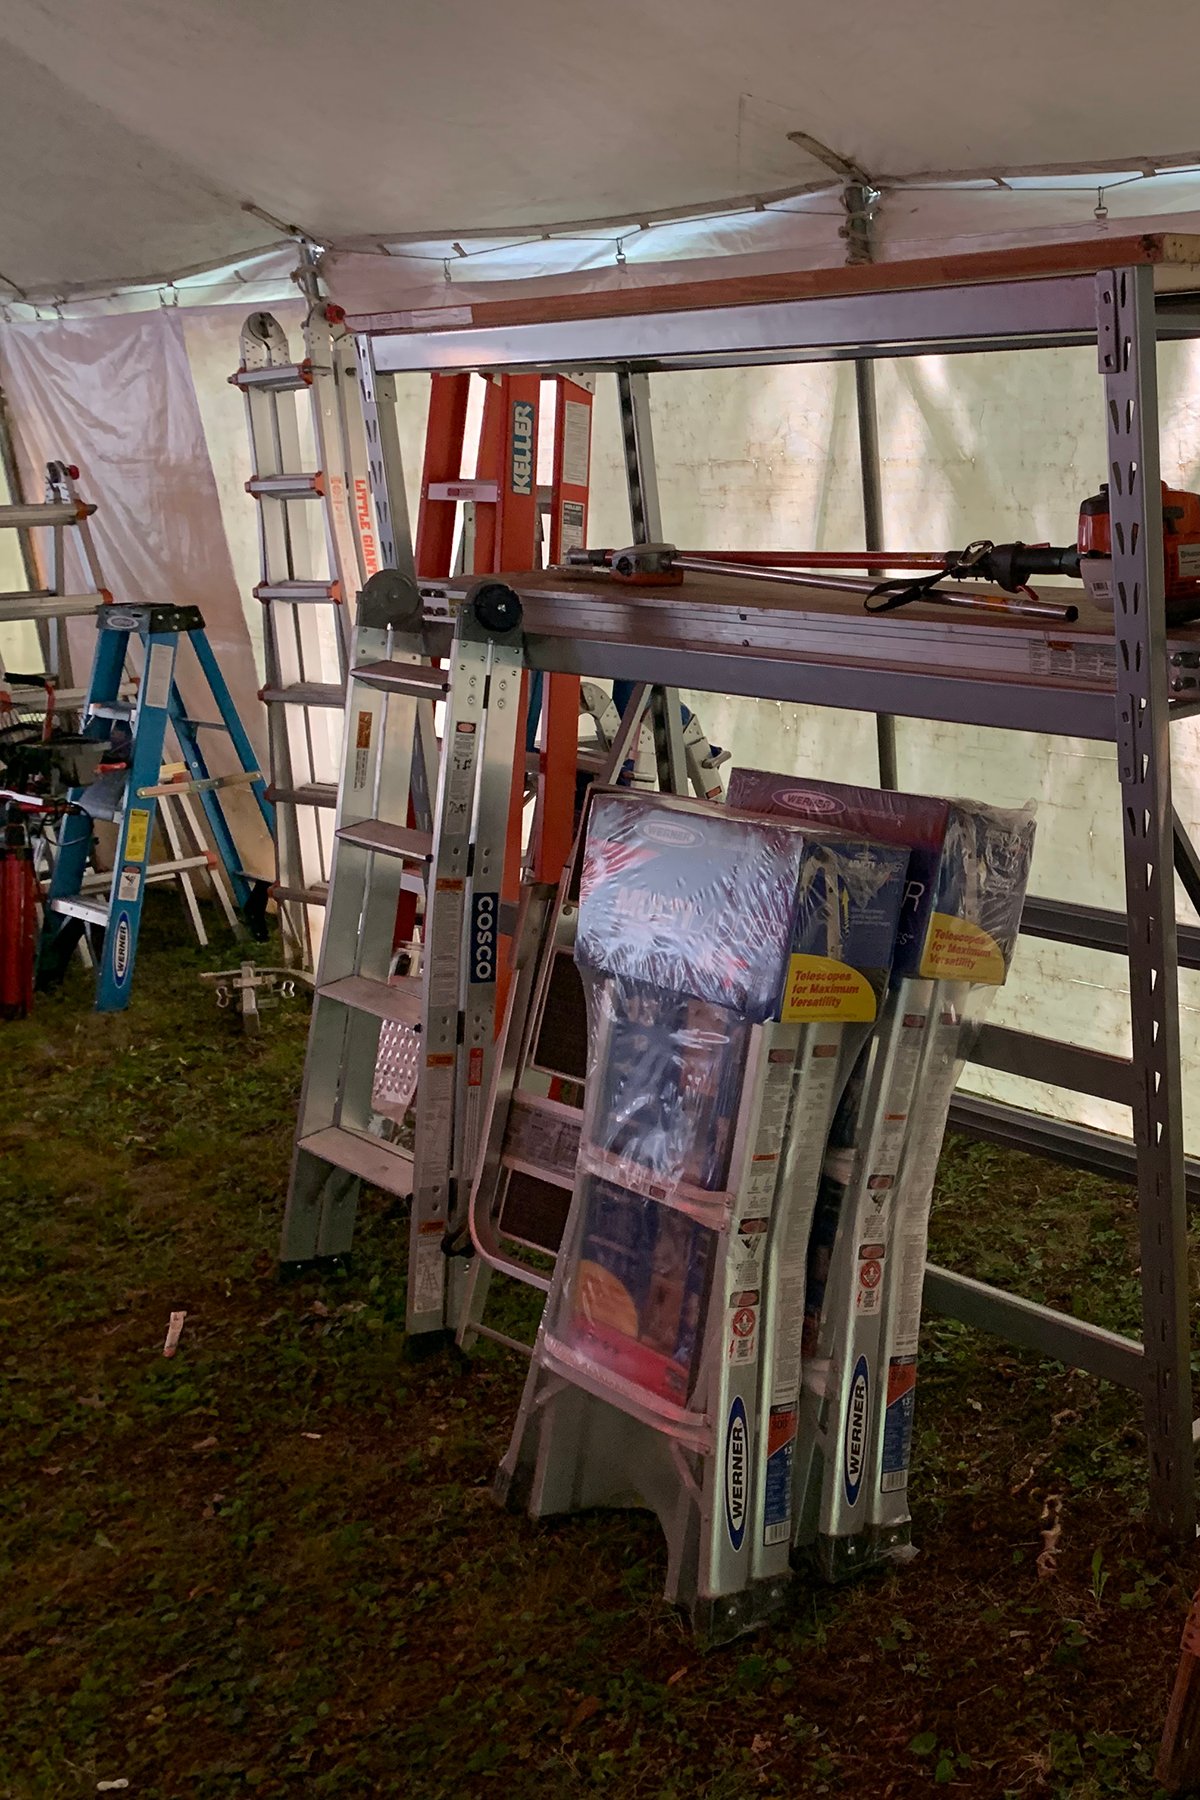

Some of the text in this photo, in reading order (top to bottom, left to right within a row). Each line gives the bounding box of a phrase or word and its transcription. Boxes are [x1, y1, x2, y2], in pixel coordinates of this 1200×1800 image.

[513, 404, 533, 495] KELLER
[354, 479, 378, 575] LITTLE GIANT
[786, 794, 831, 809] WERNER
[649, 826, 692, 842] WERNER
[476, 896, 494, 980] COSCO
[934, 929, 987, 944] Telescopes
[117, 926, 128, 973] WERNER
[932, 942, 992, 957] for Maximum
[928, 953, 976, 969] Versatility
[794, 970, 852, 982] Telescopes
[791, 984, 860, 994] for Maximum
[790, 996, 842, 1009] Versatility
[849, 1384, 865, 1475] WERNER
[732, 1426, 743, 1520] WERNER
